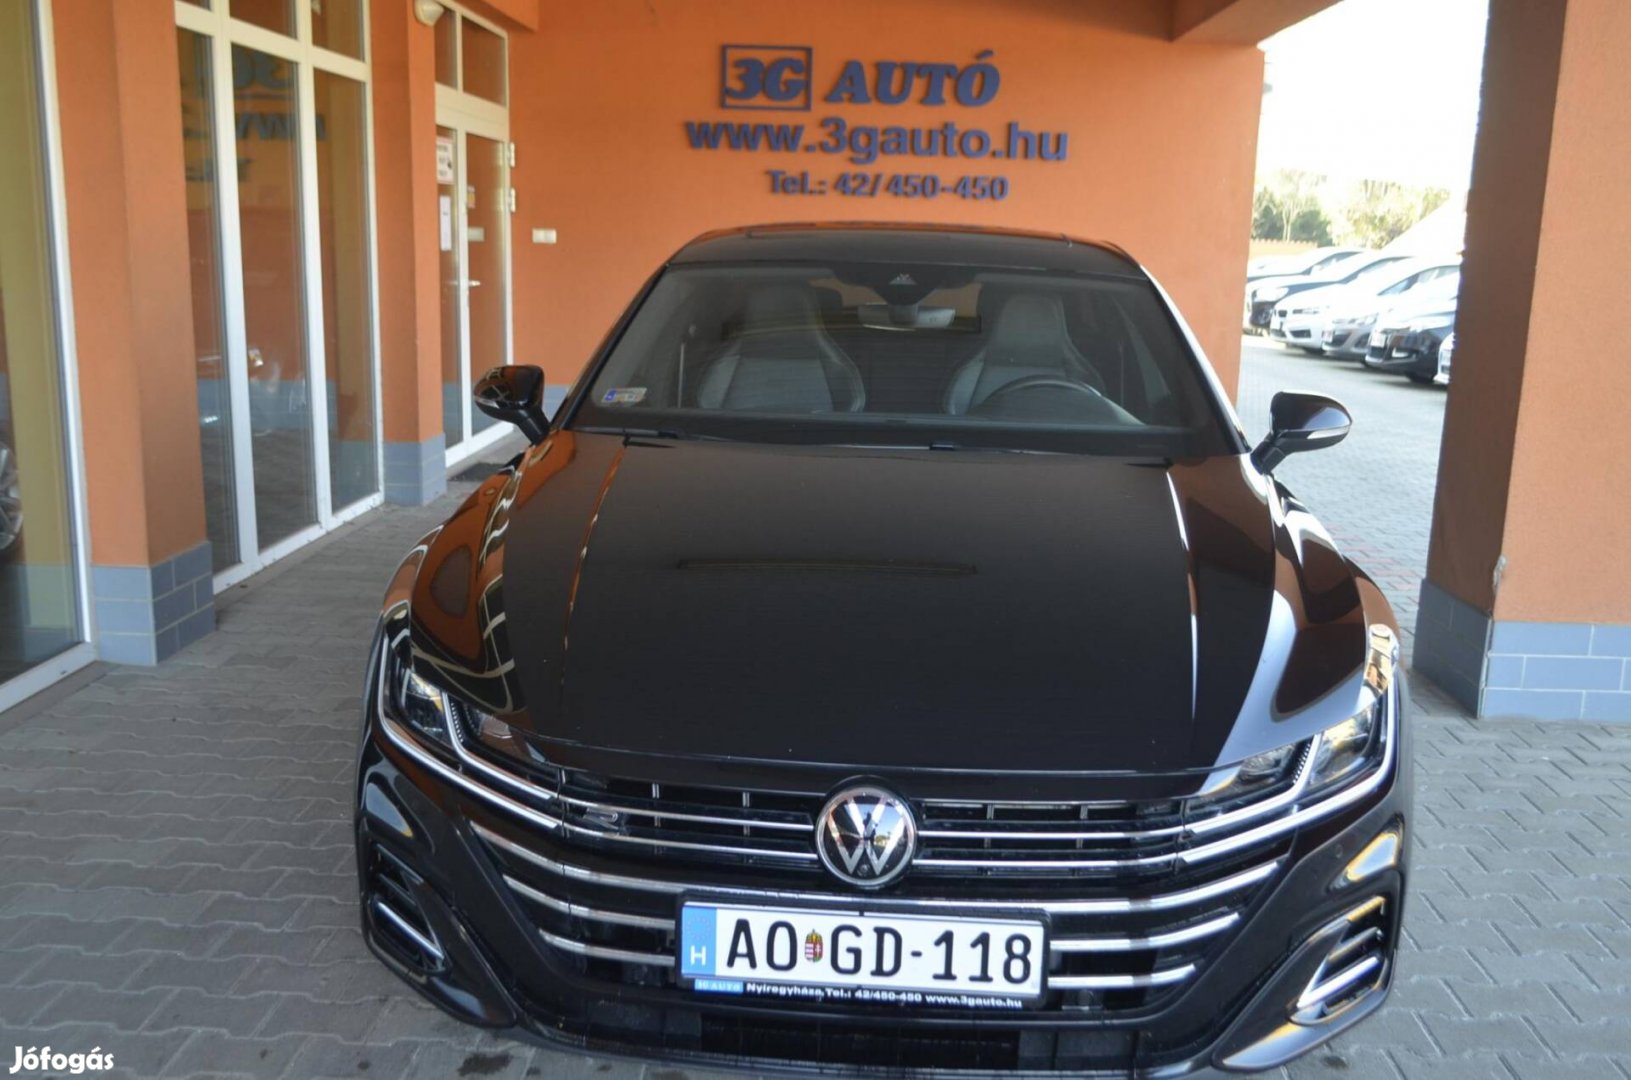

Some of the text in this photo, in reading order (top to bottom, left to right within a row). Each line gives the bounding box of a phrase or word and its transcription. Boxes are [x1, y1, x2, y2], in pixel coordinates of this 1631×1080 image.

[724, 49, 1001, 107] 3G AUTÓ
[685, 116, 1068, 164] www.3gauto.hu
[767, 170, 827, 195] Tel.:
[690, 944, 707, 966] H
[727, 918, 1032, 985] AO GD-118
